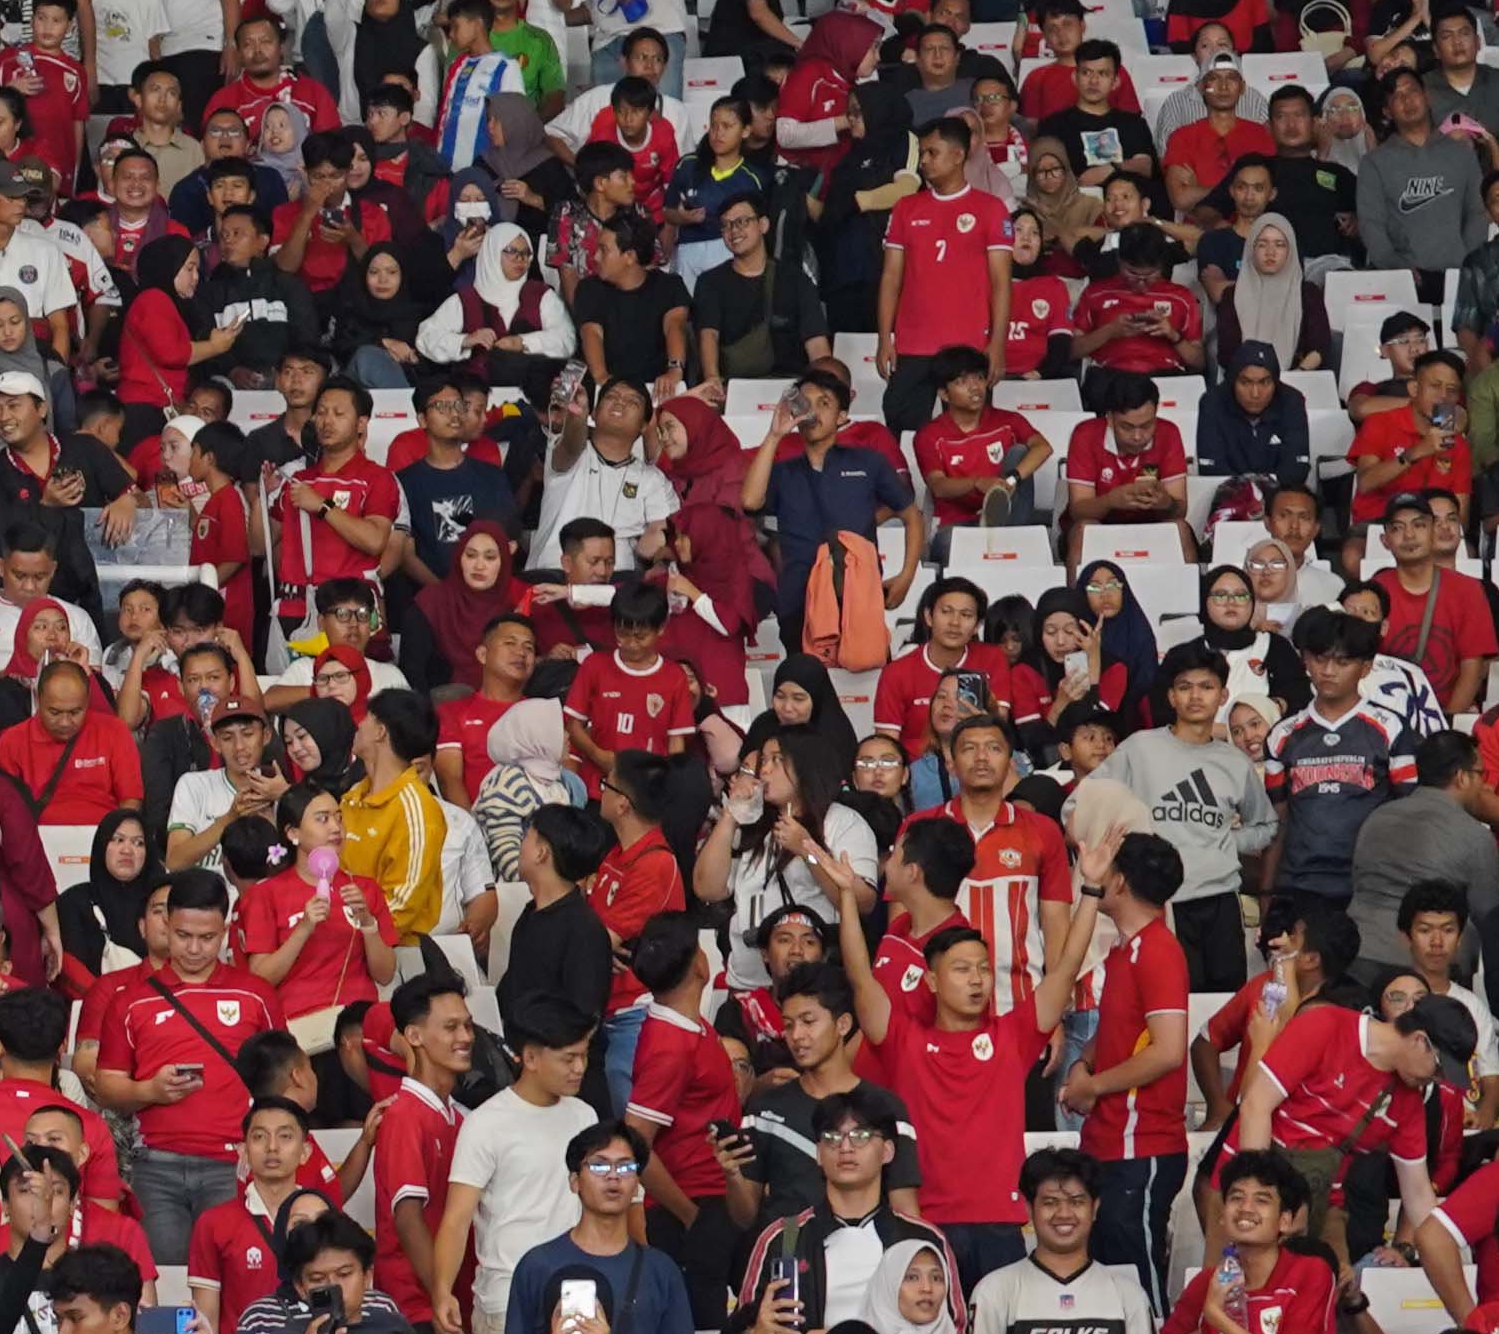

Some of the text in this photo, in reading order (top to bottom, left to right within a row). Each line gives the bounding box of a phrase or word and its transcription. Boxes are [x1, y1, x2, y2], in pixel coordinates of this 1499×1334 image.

[1406, 177, 1446, 198] NIKE
[936, 239, 948, 262] 7
[1008, 321, 1030, 341] 15
[617, 712, 635, 735] 10
[1151, 801, 1225, 830] adidas
